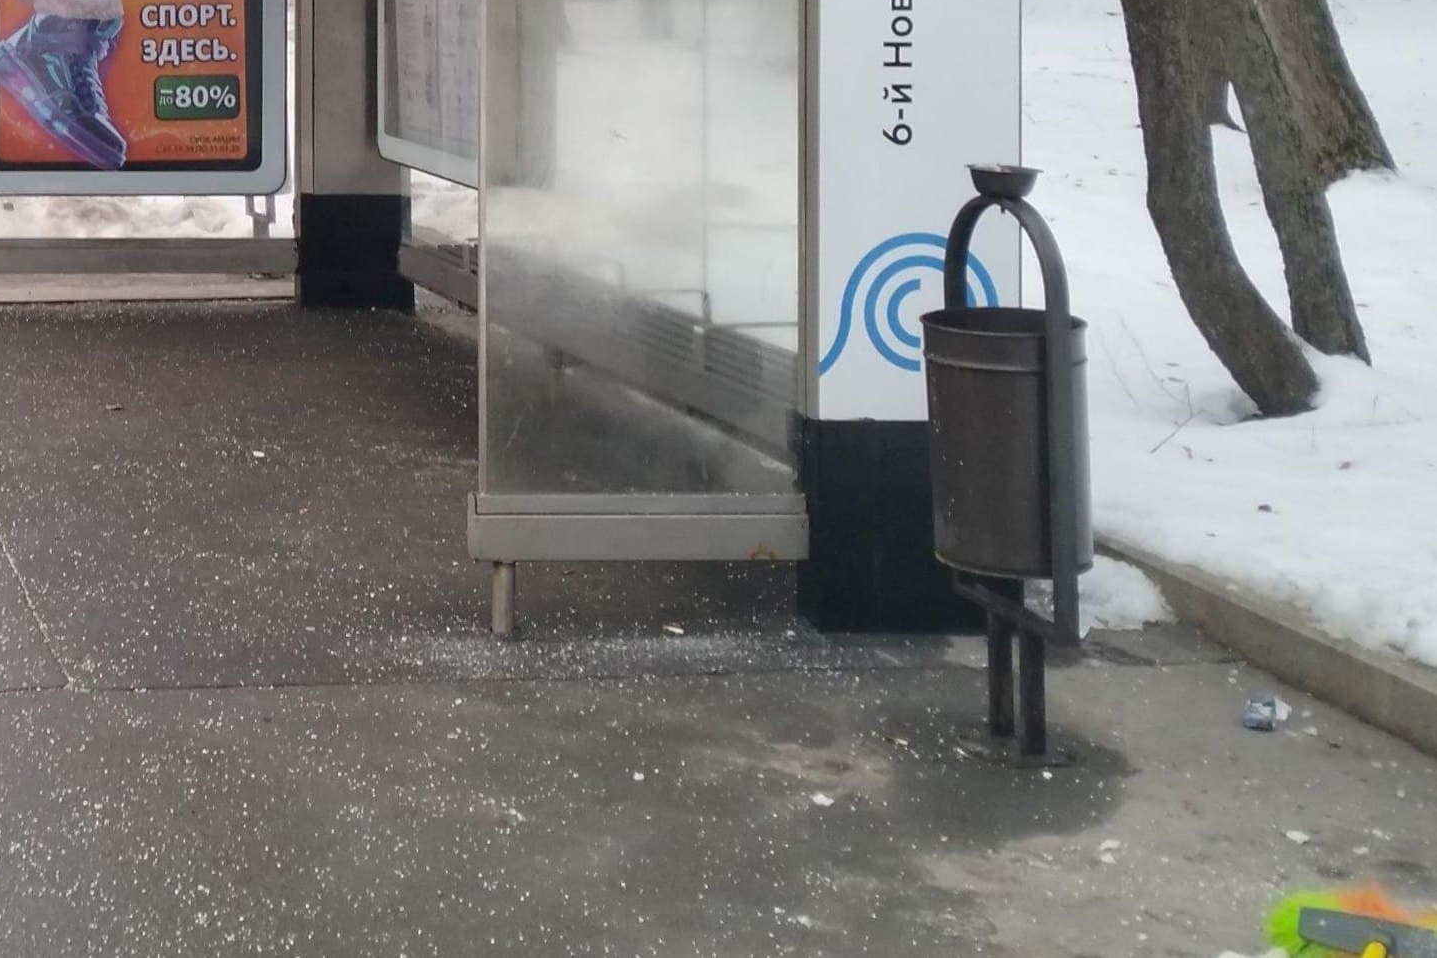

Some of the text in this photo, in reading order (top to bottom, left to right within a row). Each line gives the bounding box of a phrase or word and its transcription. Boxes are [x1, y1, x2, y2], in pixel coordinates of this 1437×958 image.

[141, 4, 237, 28] СПОРТ.
[142, 38, 238, 66] ЗДЕСЬ.
[882, 83, 914, 146] 6-й
